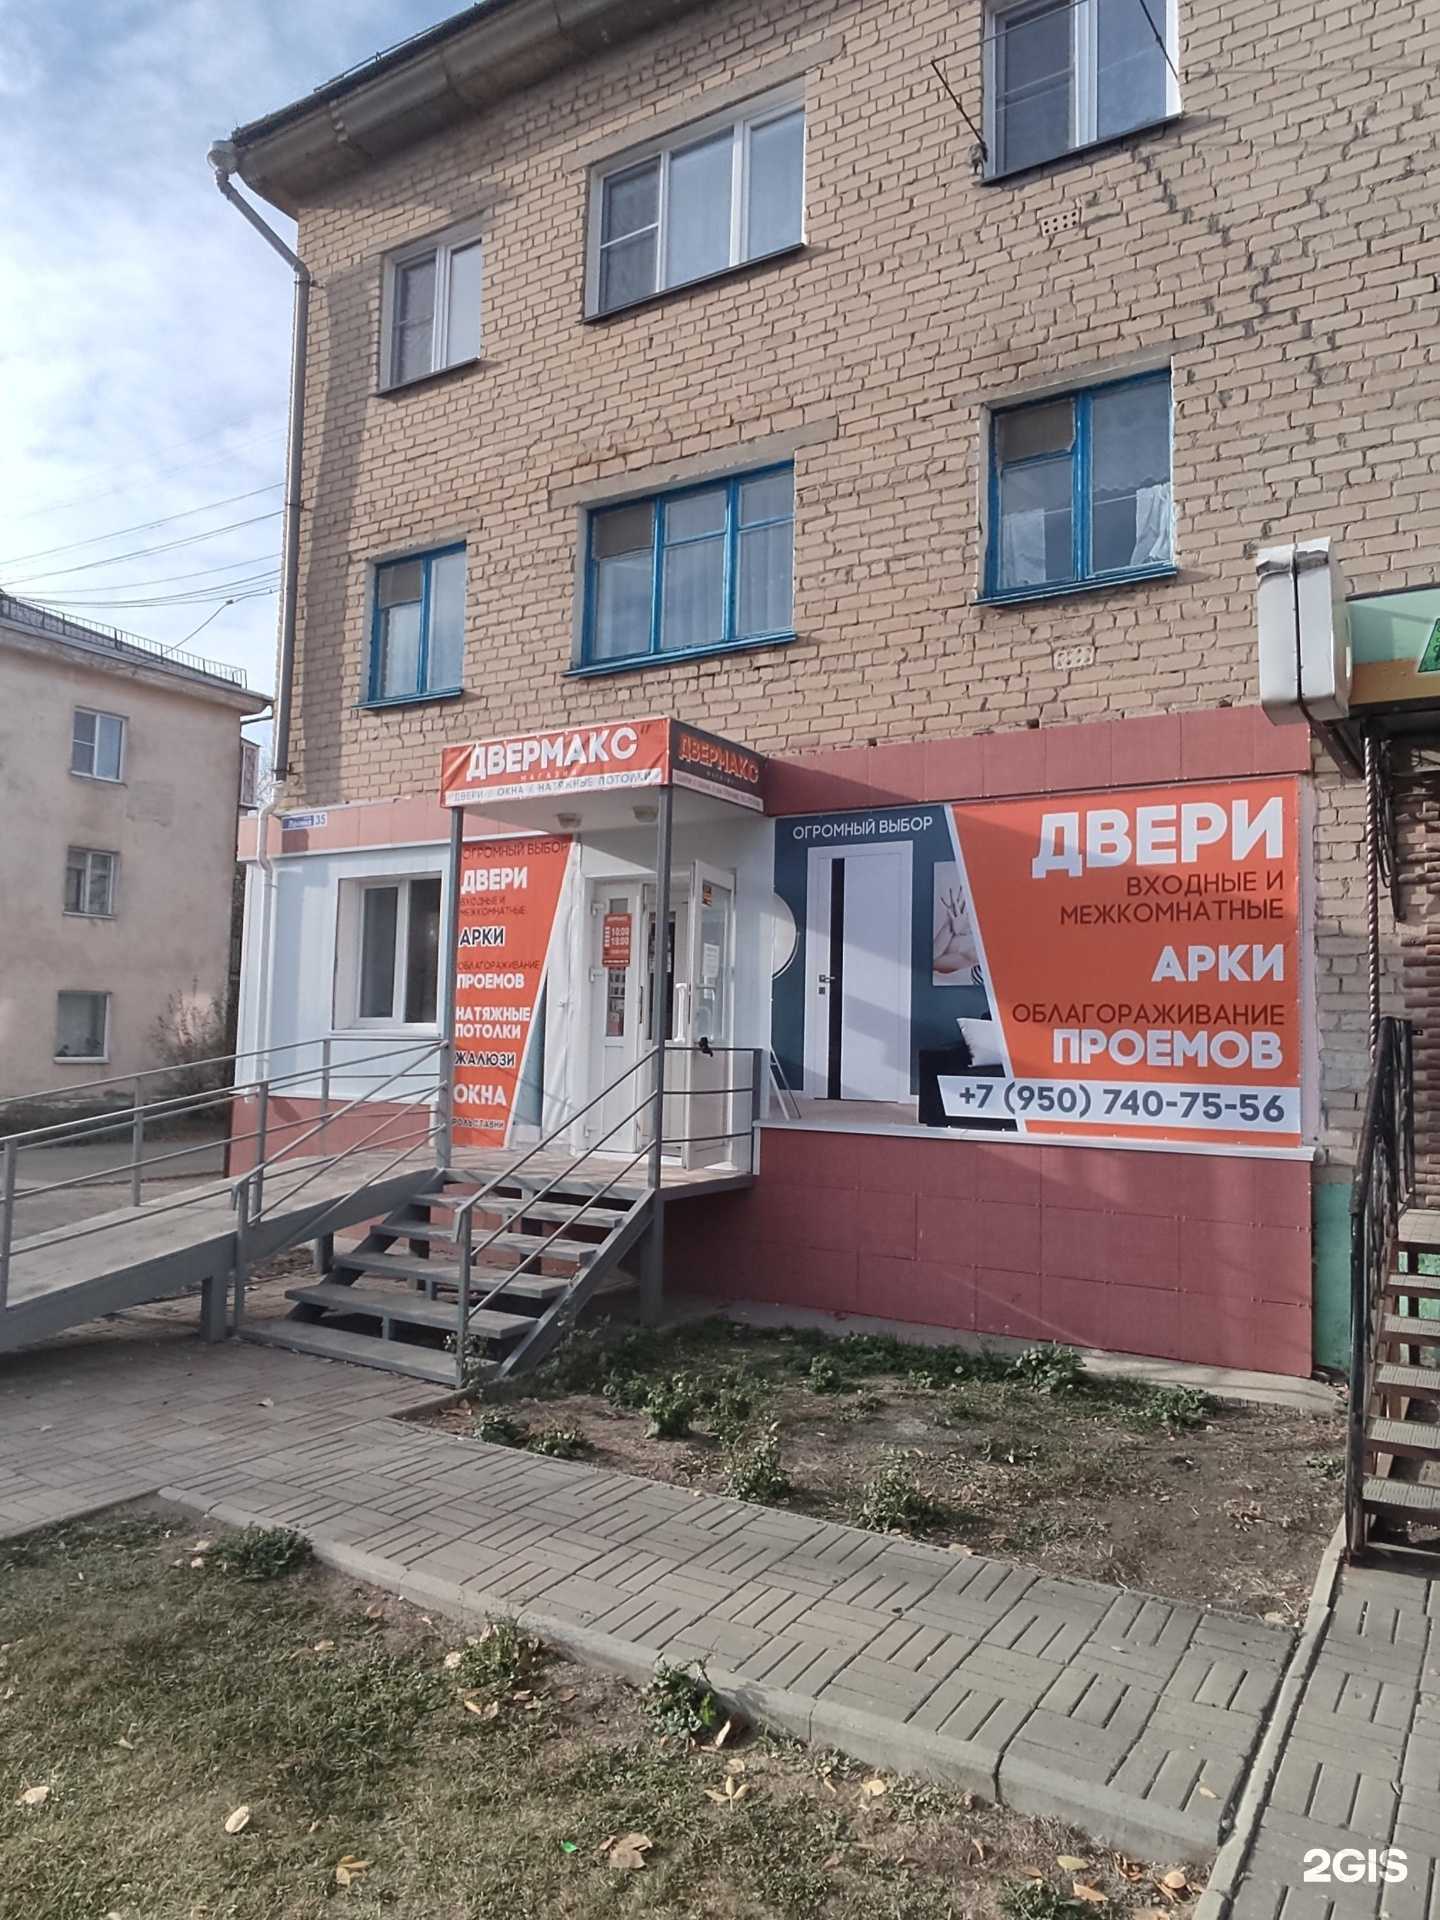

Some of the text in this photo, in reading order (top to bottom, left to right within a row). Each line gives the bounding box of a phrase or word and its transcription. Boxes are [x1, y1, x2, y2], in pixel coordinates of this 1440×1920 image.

[466, 727, 638, 781] ДВЕРМАКС
[678, 733, 760, 784] ДВЕРМАКС
[496, 786, 523, 796] ОКНА
[793, 815, 933, 841] ОГРОМНЫЙ ВЫБОР
[1031, 797, 1284, 880] ДВЕРИ
[463, 840, 569, 860] ОГРОМНЫЙ ВЫБОР
[461, 867, 528, 894] ДВЕРИ
[1127, 869, 1284, 898] ВХОДНЫЕ И
[1060, 898, 1284, 925] МЕЖКОМНАТНЫЕ
[459, 926, 506, 948] АРКИ
[458, 960, 540, 971] ОБЛАГОРАЖИВАНИЕ
[1151, 944, 1284, 982] АРКИ
[457, 973, 525, 989] ПРОЕМОВ
[455, 1007, 531, 1022] НАТЯЖНЫЕ
[1012, 1003, 1285, 1026] ОБЛАГОРАЖИВАНИЕ
[455, 1022, 521, 1039] ПОТОЛКИ
[455, 1051, 516, 1068] ЖАЛЮЗИ
[1053, 1029, 1283, 1069] ПРОЕМОВ
[453, 1083, 507, 1106] ОКНА
[959, 1081, 1285, 1123] +7 (950) 740-75-56
